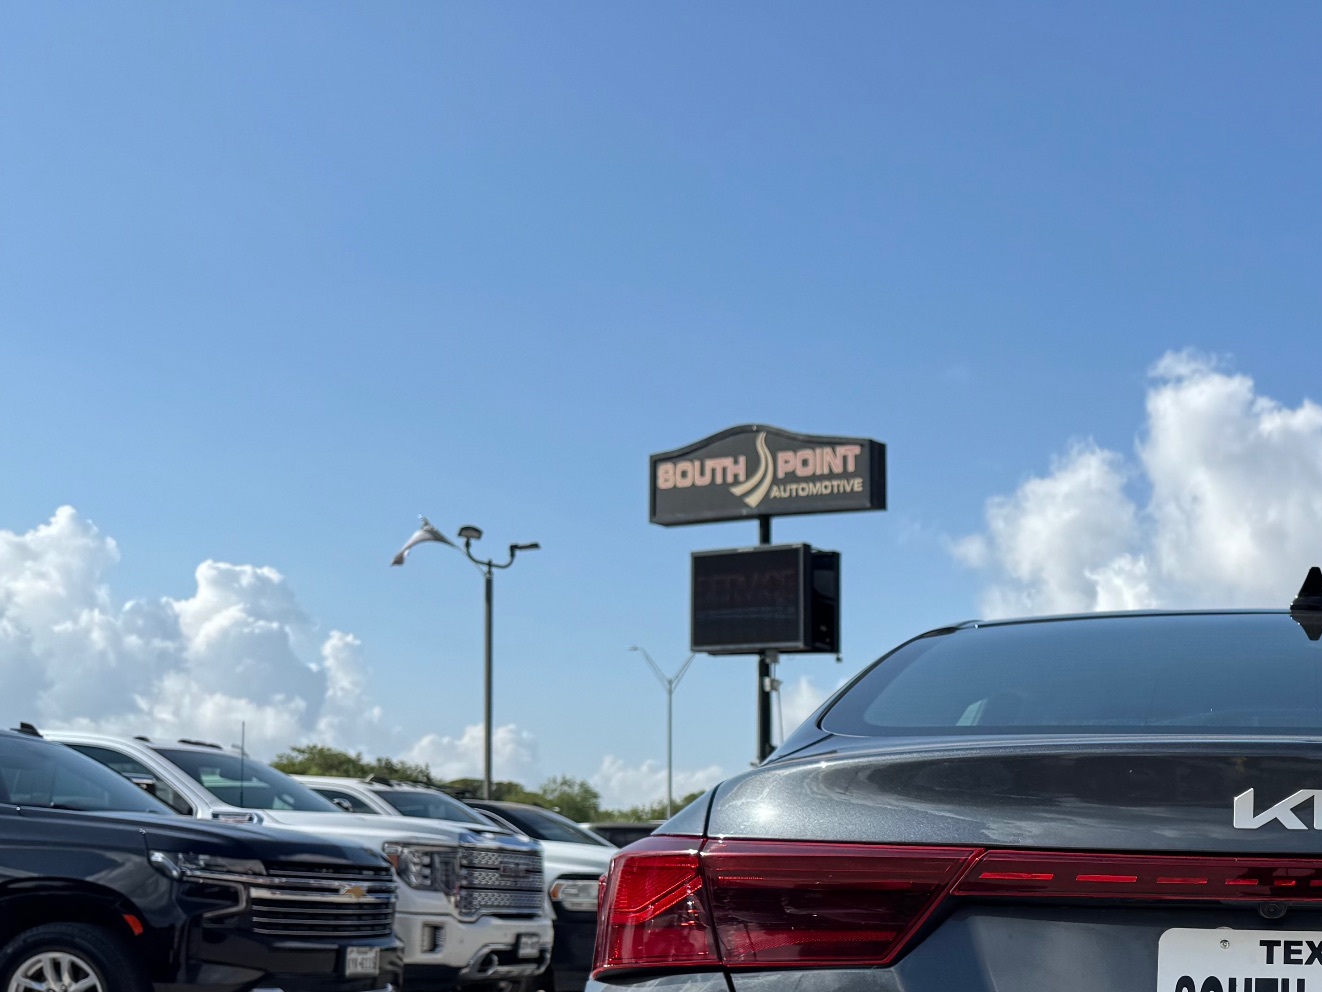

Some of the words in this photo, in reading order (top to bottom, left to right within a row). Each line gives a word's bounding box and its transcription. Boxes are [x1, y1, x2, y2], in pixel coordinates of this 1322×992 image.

[657, 455, 746, 489] SOUTH
[777, 445, 862, 479] POINT
[769, 478, 863, 499] AUTOMOTIVE
